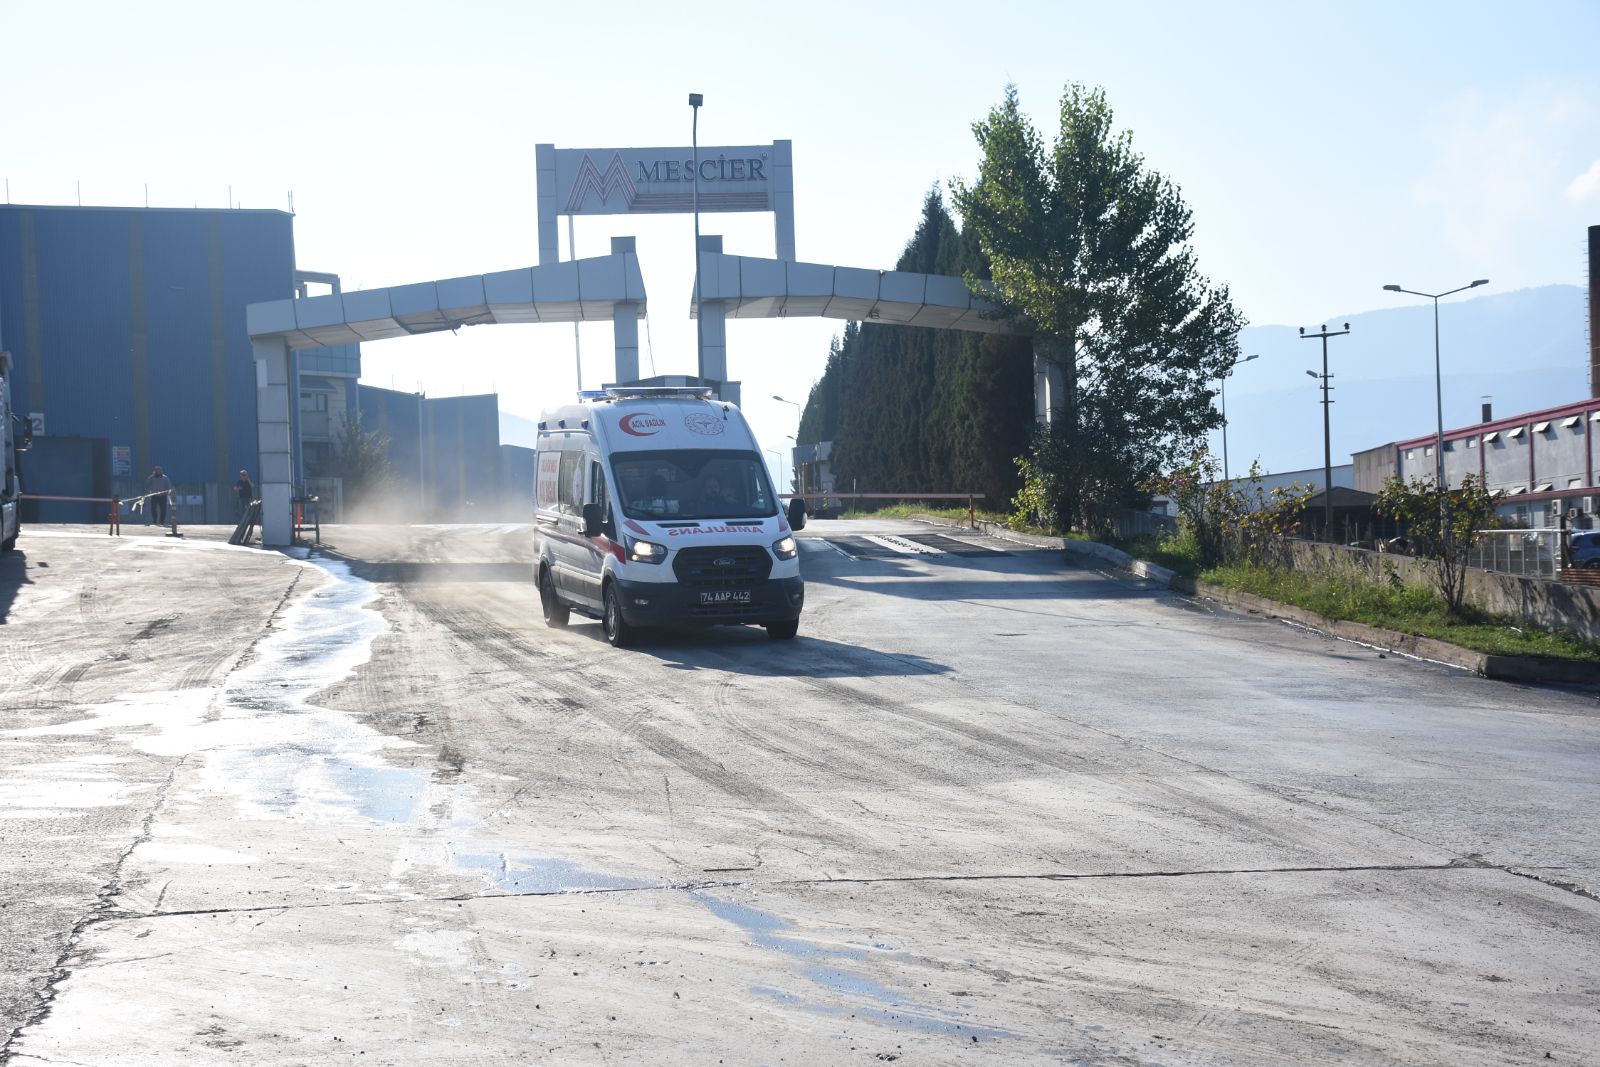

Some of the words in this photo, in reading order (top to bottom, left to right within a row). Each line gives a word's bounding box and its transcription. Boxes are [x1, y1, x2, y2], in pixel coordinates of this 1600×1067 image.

[638, 154, 768, 182] MESCİER
[702, 592, 713, 602] 74
[733, 591, 750, 600] 442
